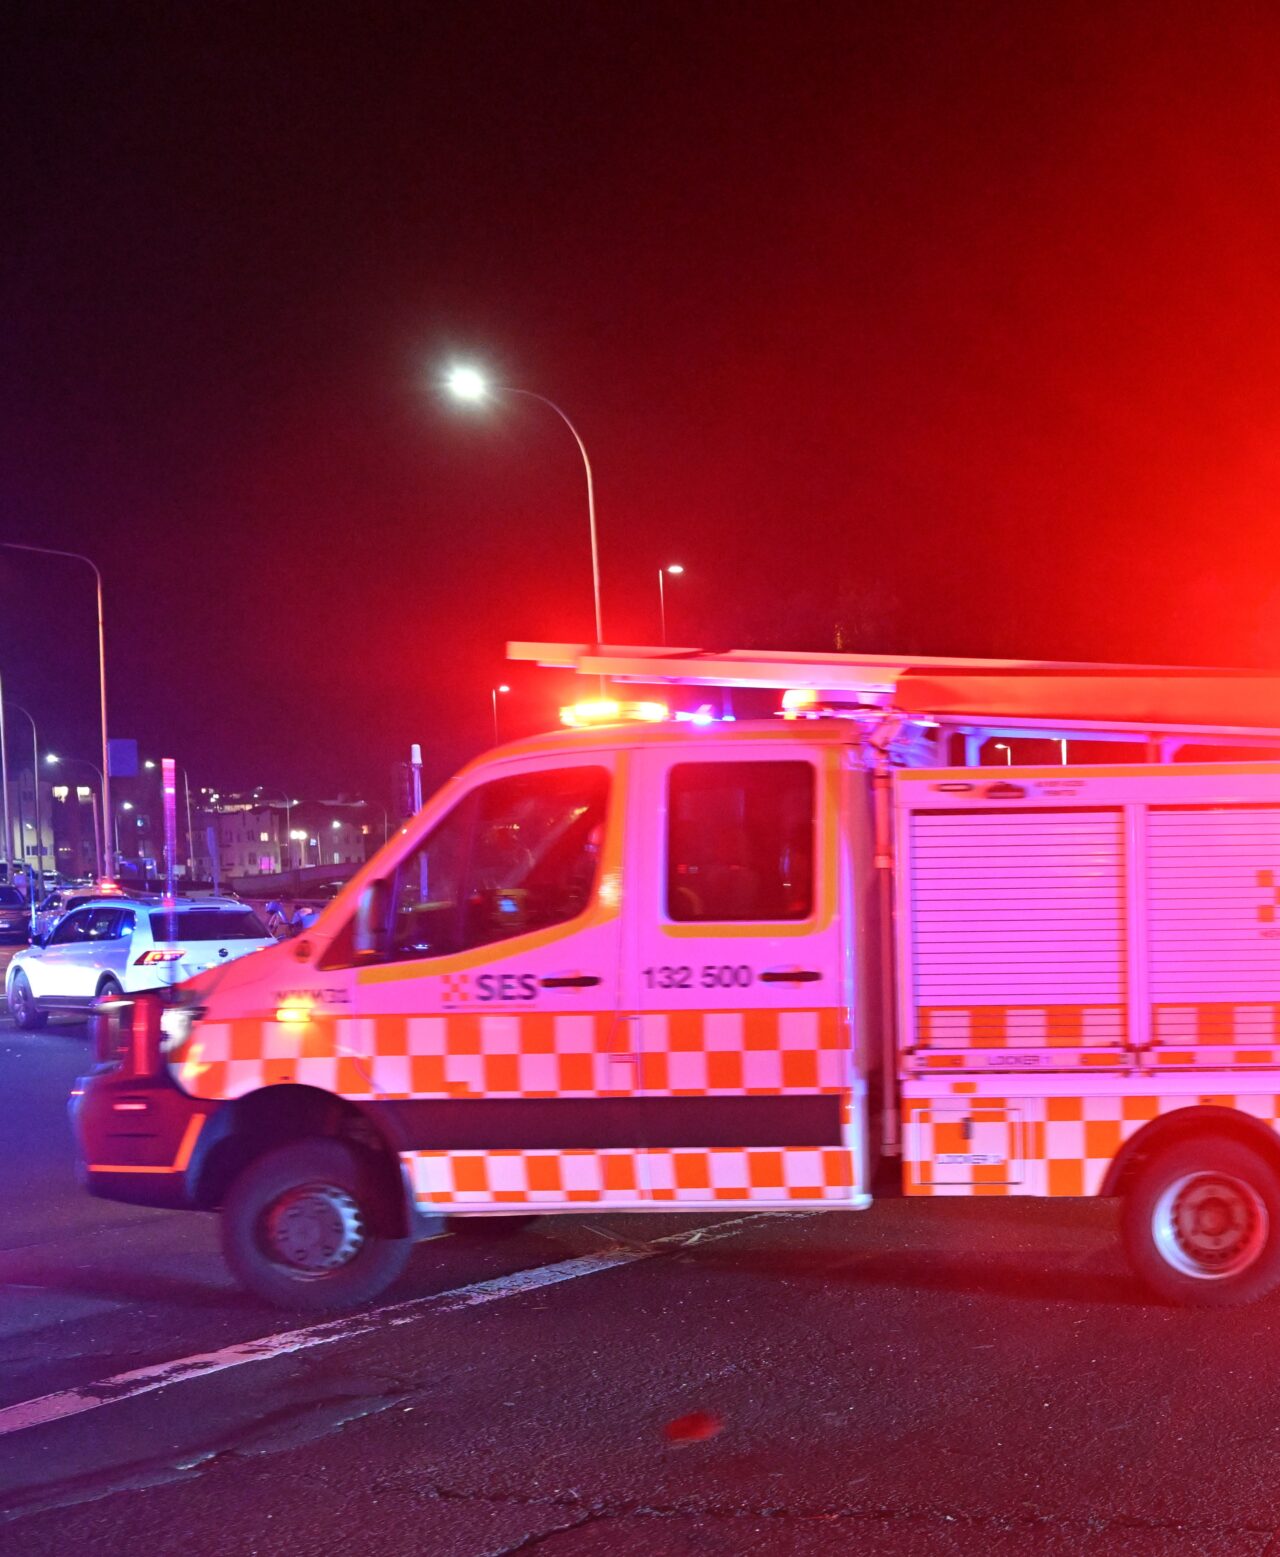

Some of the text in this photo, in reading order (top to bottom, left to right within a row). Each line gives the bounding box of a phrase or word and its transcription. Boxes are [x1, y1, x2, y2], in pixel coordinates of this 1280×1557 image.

[476, 973, 538, 1001] SES
[642, 965, 752, 989] 132 500
